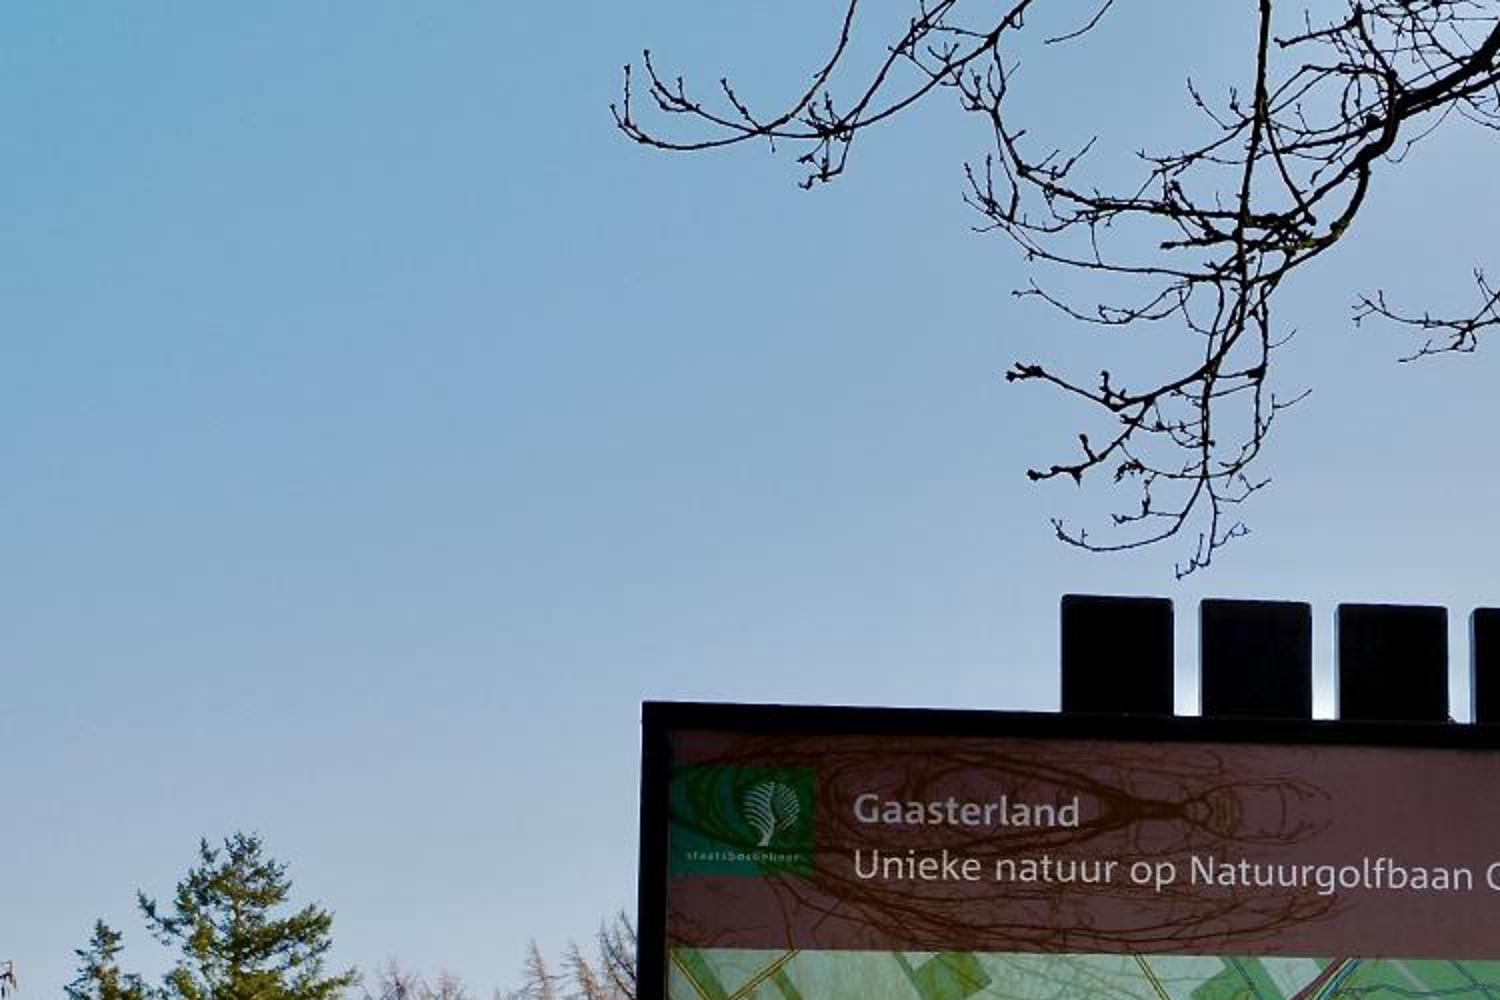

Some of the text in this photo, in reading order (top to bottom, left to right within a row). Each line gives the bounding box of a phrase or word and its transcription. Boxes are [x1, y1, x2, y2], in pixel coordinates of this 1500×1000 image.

[854, 793, 1080, 829] Gaasterland
[854, 850, 981, 882] Unieke
[994, 855, 1119, 884] natuur
[1129, 862, 1177, 892] op
[1189, 856, 1473, 894] Natuurgolfbaan
